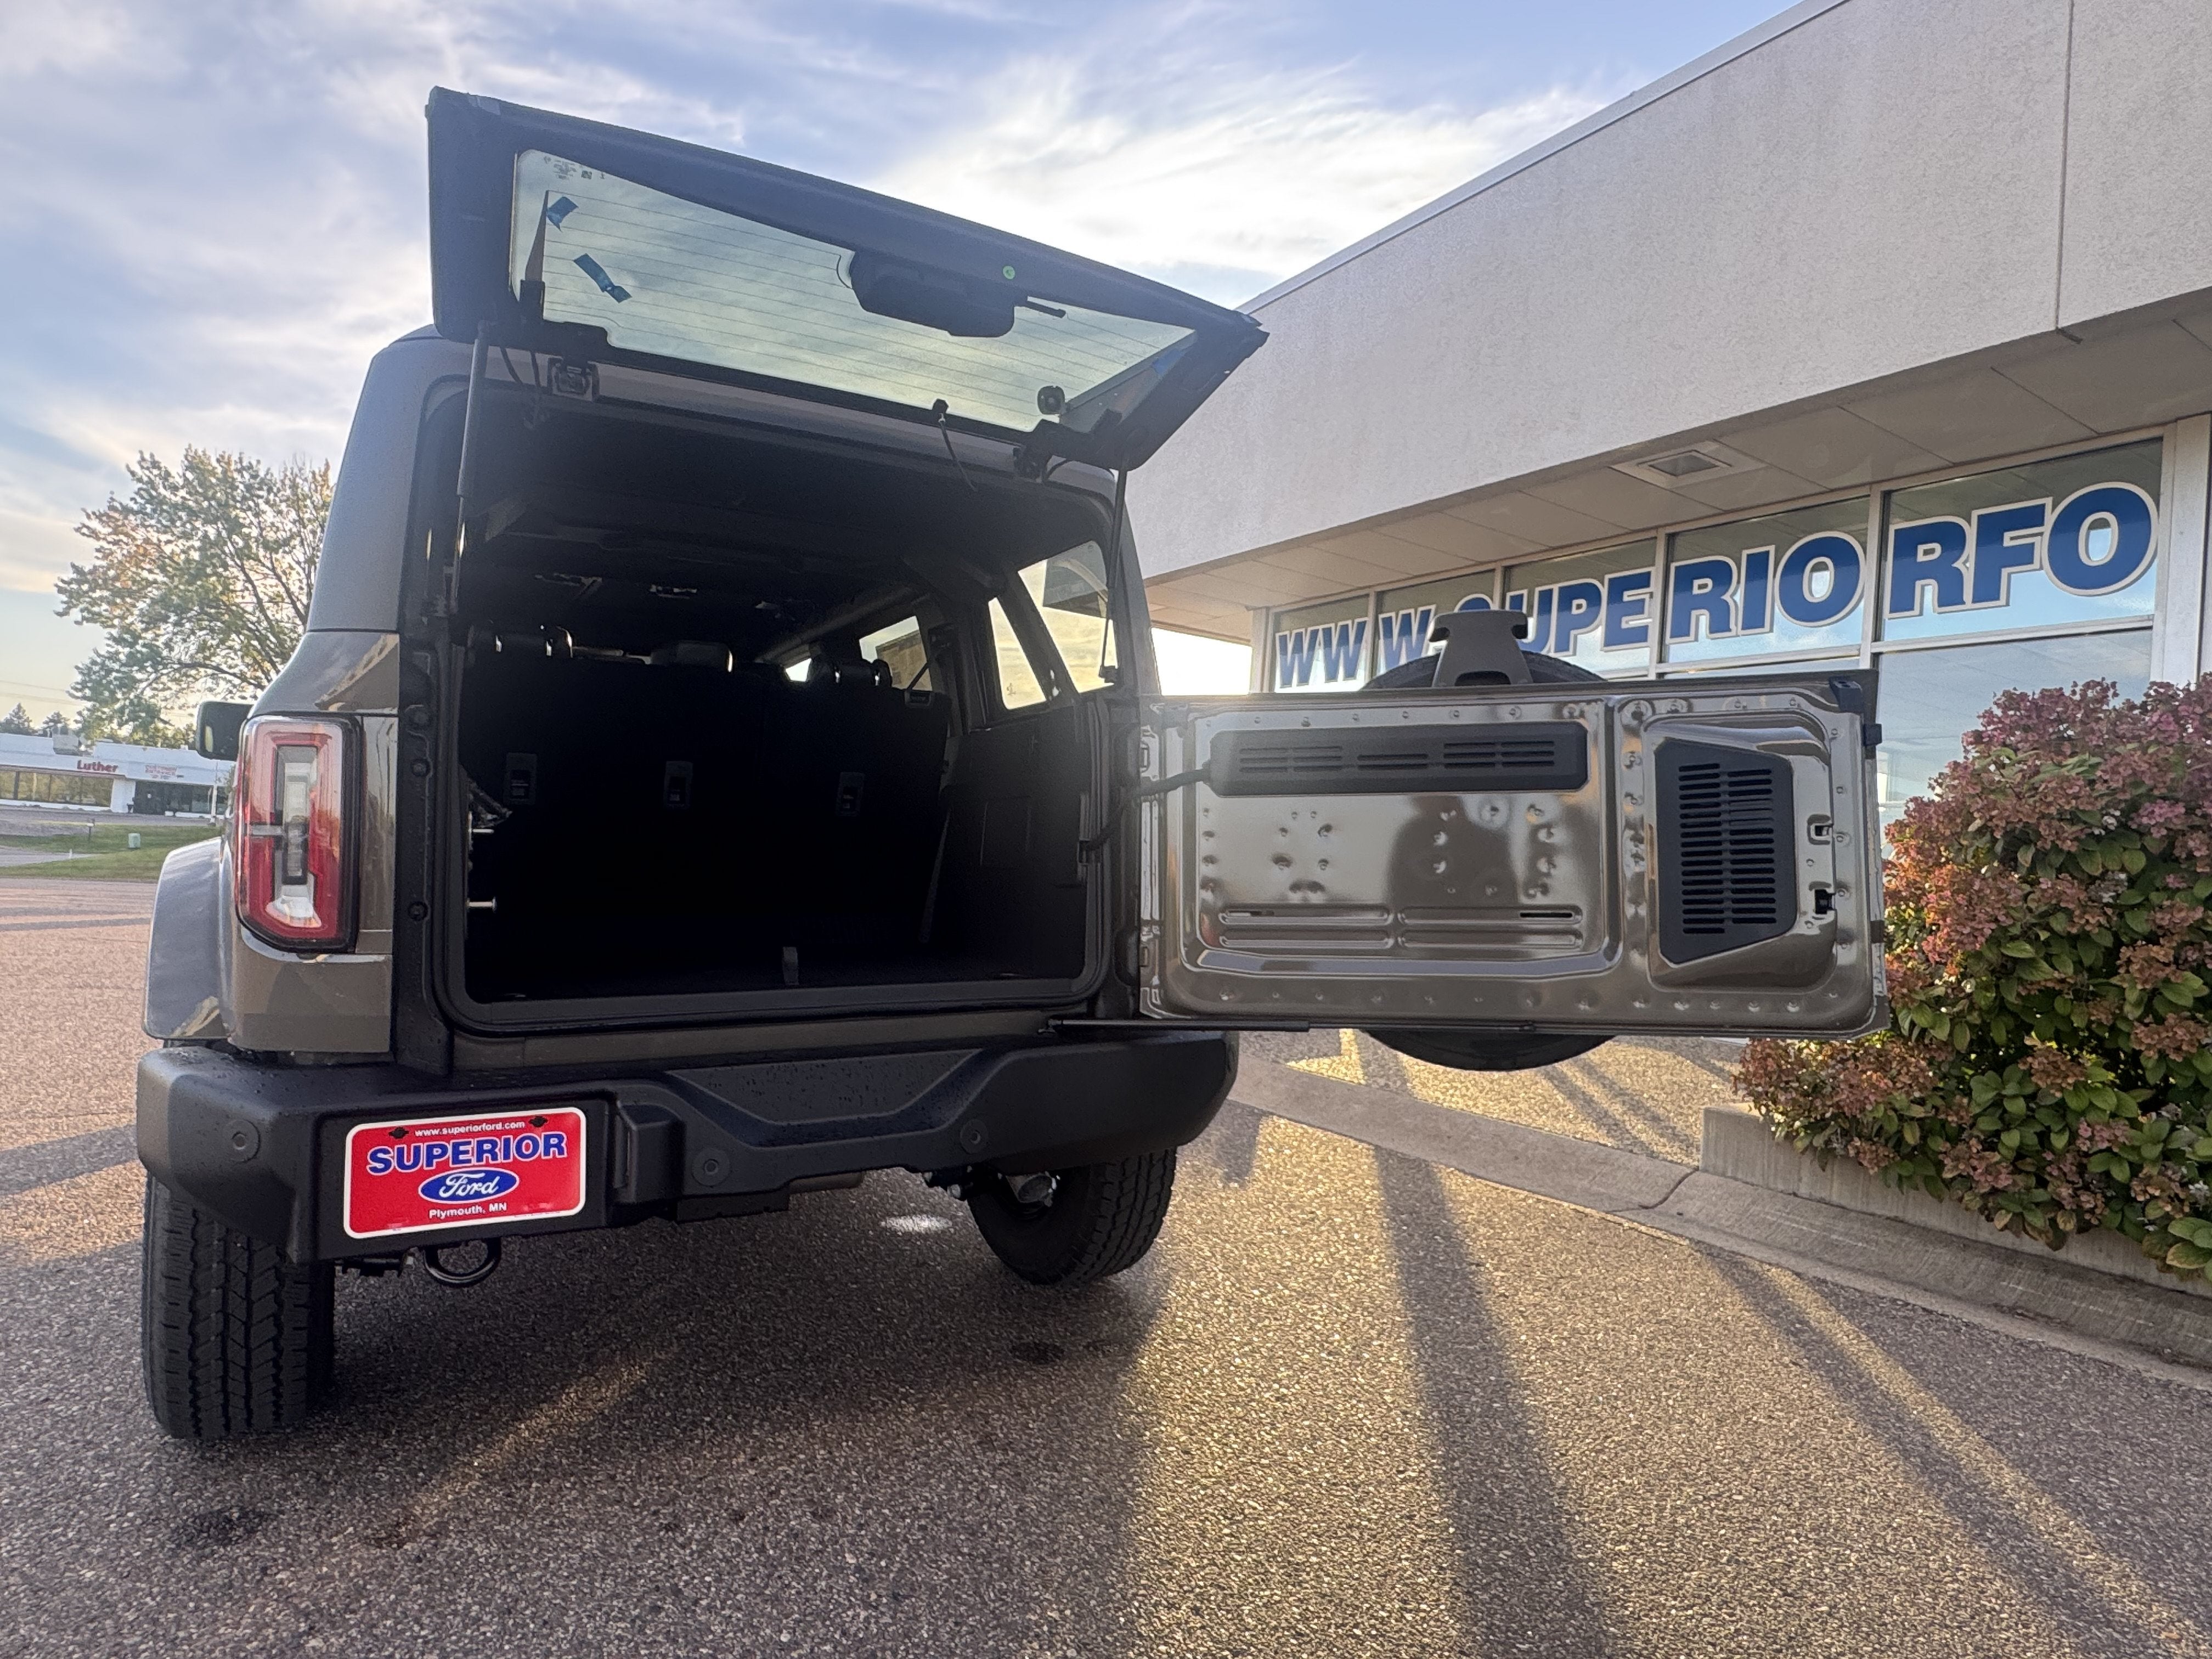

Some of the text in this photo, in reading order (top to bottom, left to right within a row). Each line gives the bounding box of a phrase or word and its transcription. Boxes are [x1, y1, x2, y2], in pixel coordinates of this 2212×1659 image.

[77, 760, 119, 773] Luther
[415, 1121, 526, 1137] www.superiorford.com
[366, 1131, 567, 1176] SUPERIOR
[439, 1172, 500, 1198] Ford
[489, 1202, 507, 1212] MN
